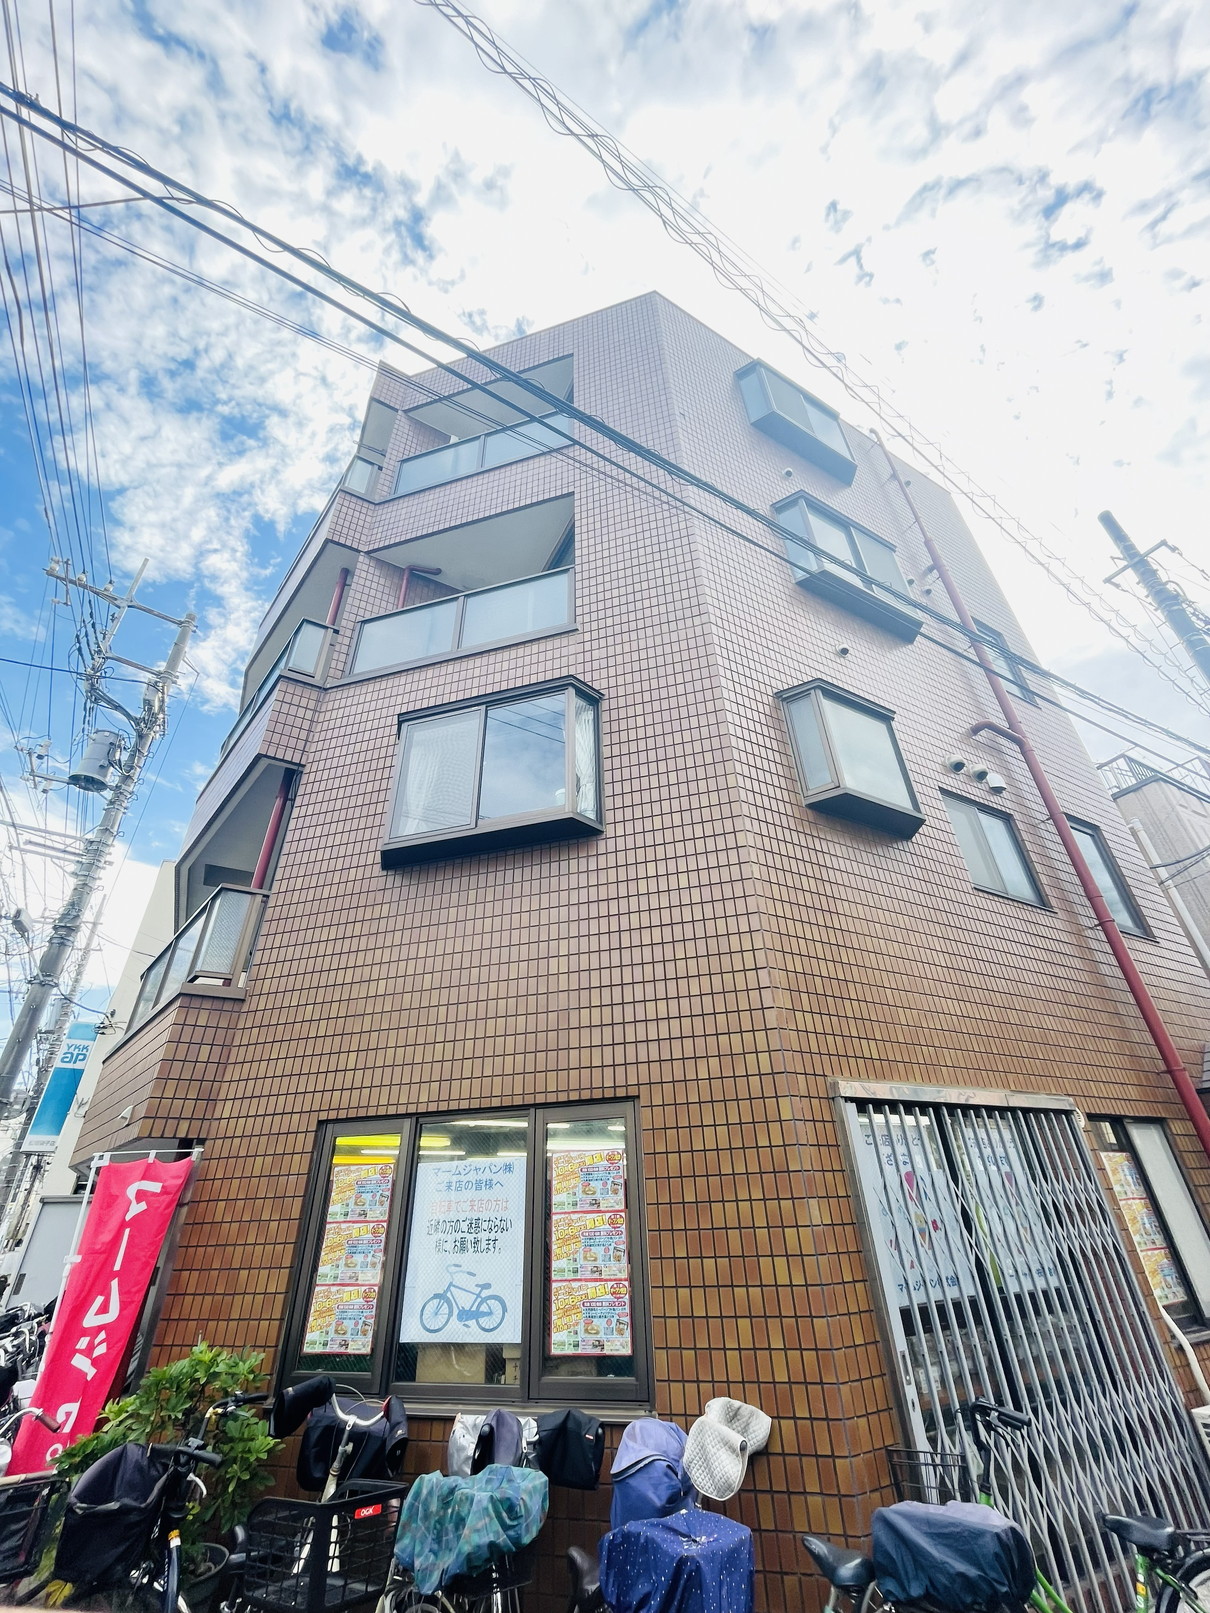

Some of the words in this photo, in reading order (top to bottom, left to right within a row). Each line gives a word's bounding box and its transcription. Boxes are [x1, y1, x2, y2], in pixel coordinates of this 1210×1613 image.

[66, 1043, 90, 1053] YKK
[436, 1179, 504, 1192] ご来店の皆様へ
[431, 1197, 509, 1216] 自転車でご来店の方は
[427, 1216, 513, 1235] 近隣の方のご迷惑にならない
[435, 1236, 502, 1254] 様に、お願い致します。
